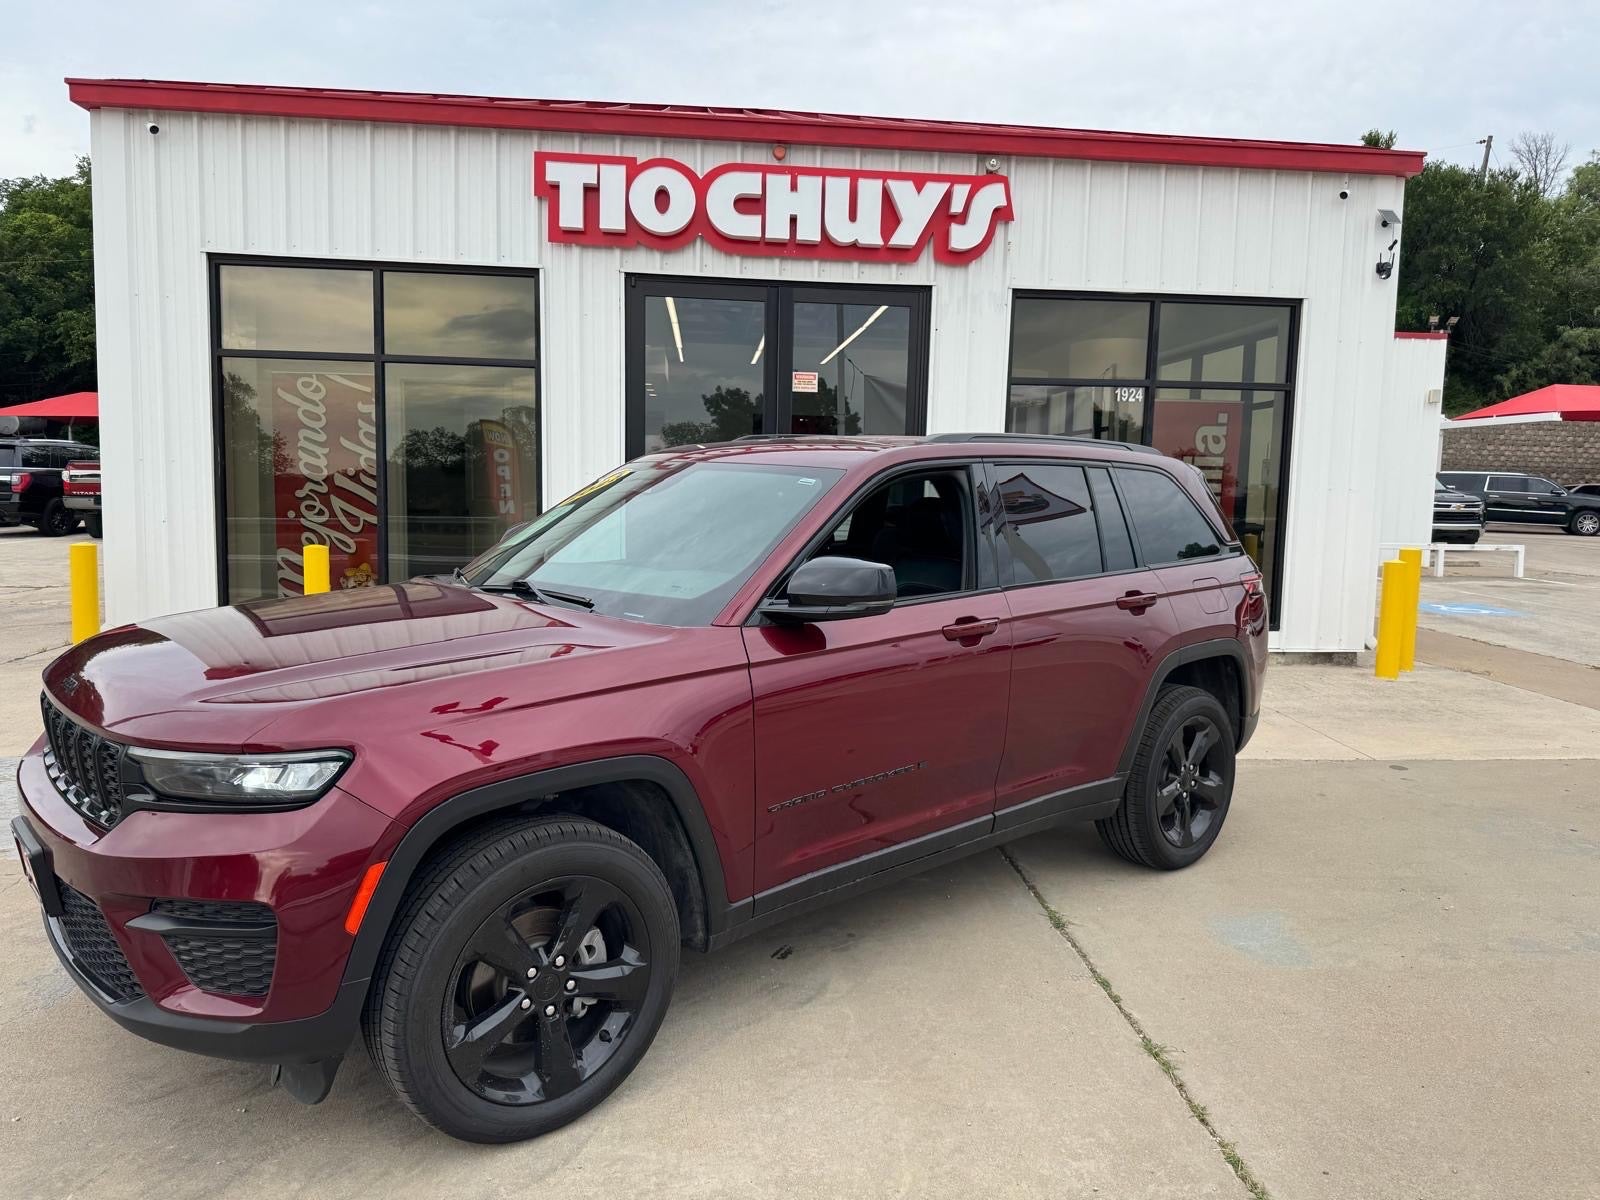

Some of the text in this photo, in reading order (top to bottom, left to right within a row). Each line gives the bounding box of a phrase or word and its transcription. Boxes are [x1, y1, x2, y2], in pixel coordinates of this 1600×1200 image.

[545, 161, 1007, 252] TIO CHUY'S
[1115, 387, 1143, 402] 1924
